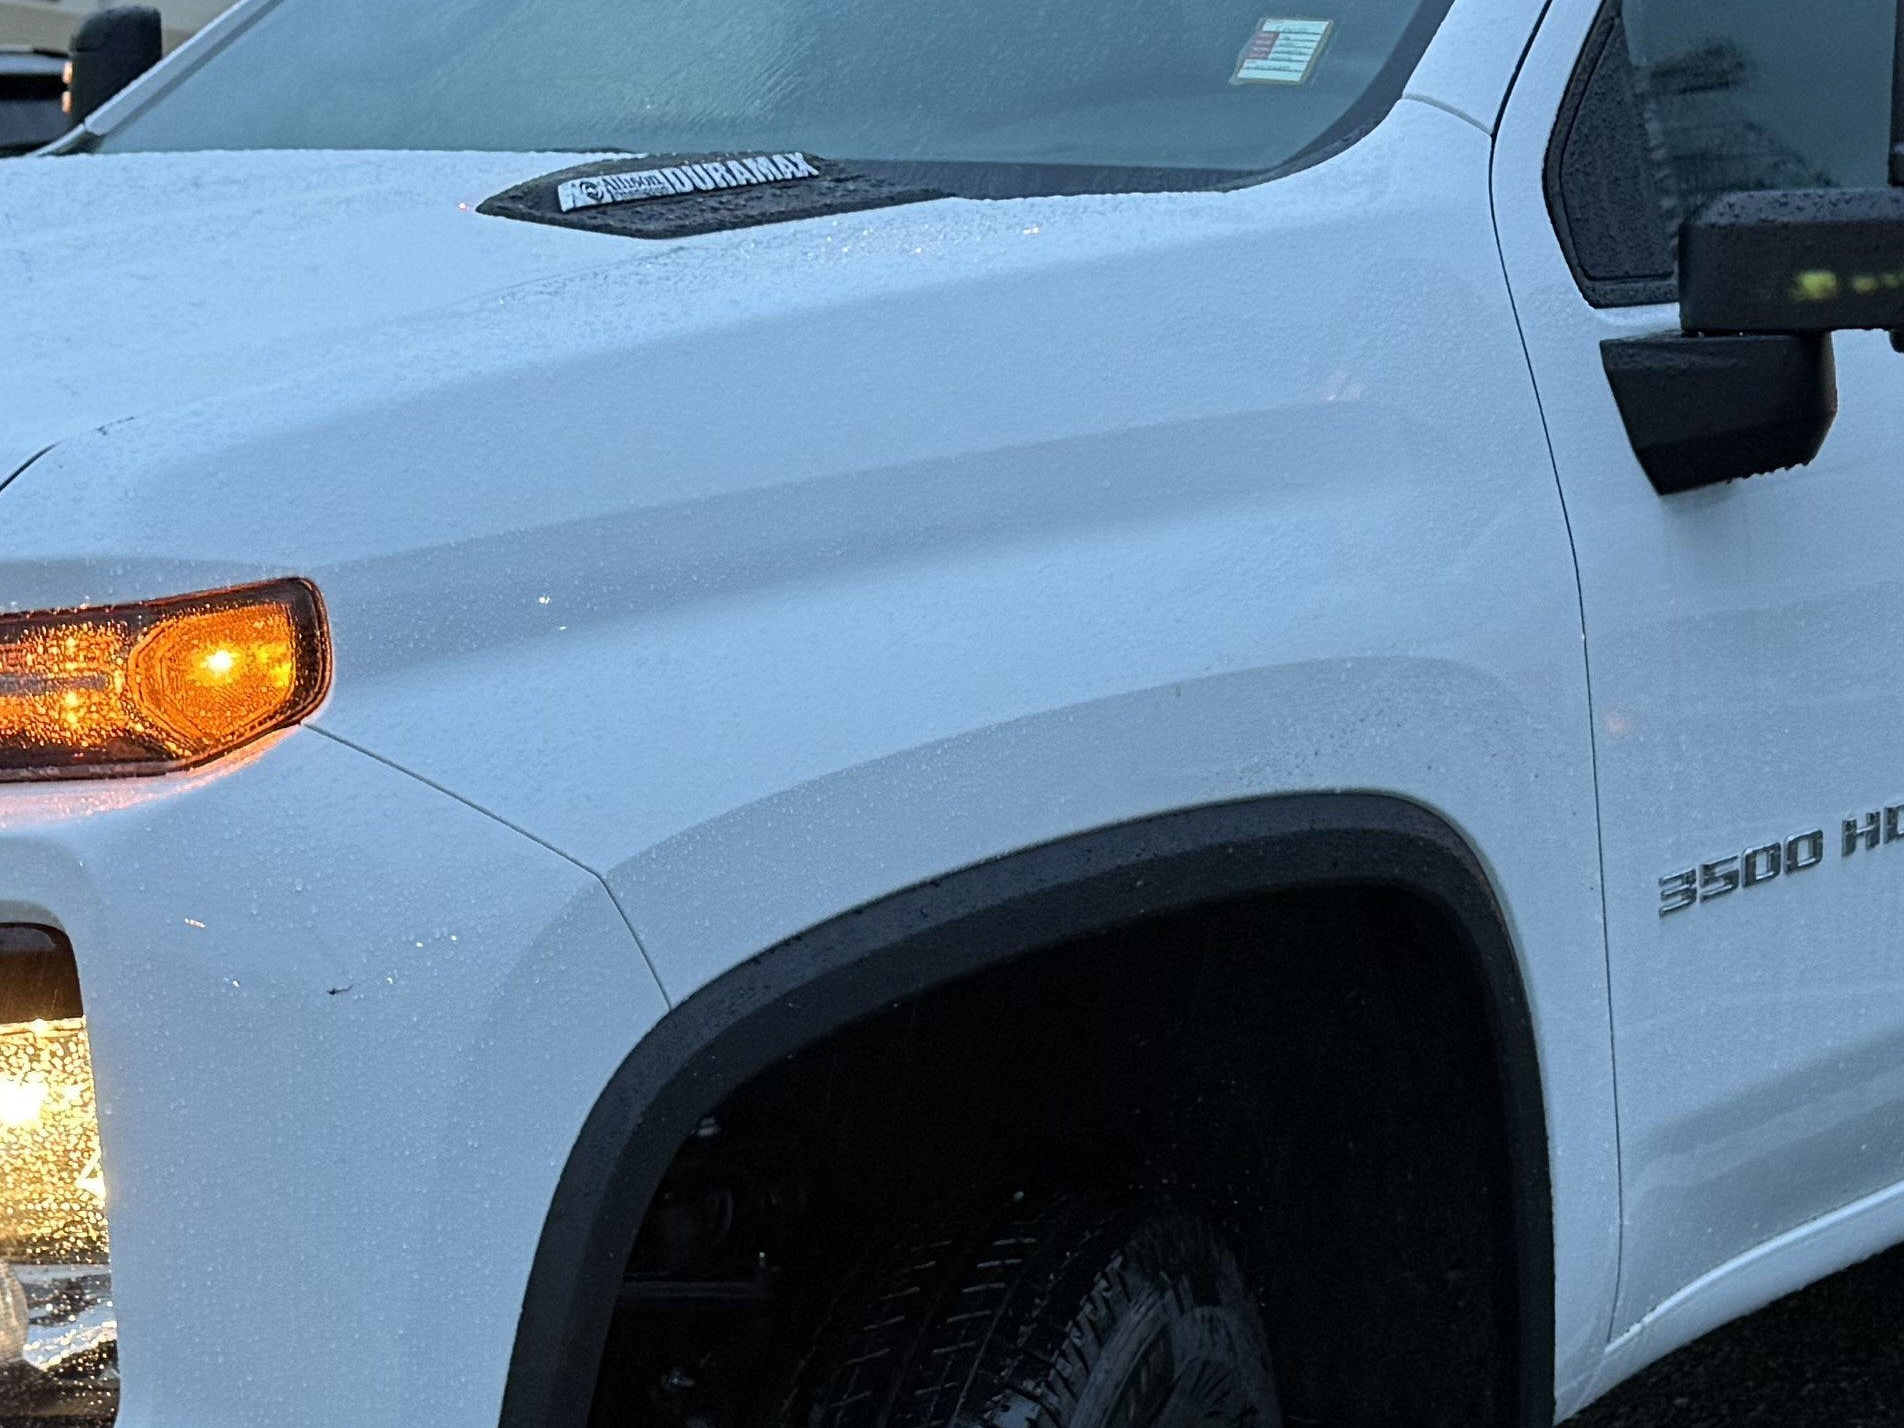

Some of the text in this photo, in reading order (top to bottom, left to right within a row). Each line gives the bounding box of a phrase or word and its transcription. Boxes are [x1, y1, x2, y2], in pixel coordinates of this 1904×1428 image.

[602, 152, 821, 197] Allison DURAMAX
[1657, 828, 1824, 920] 3500
